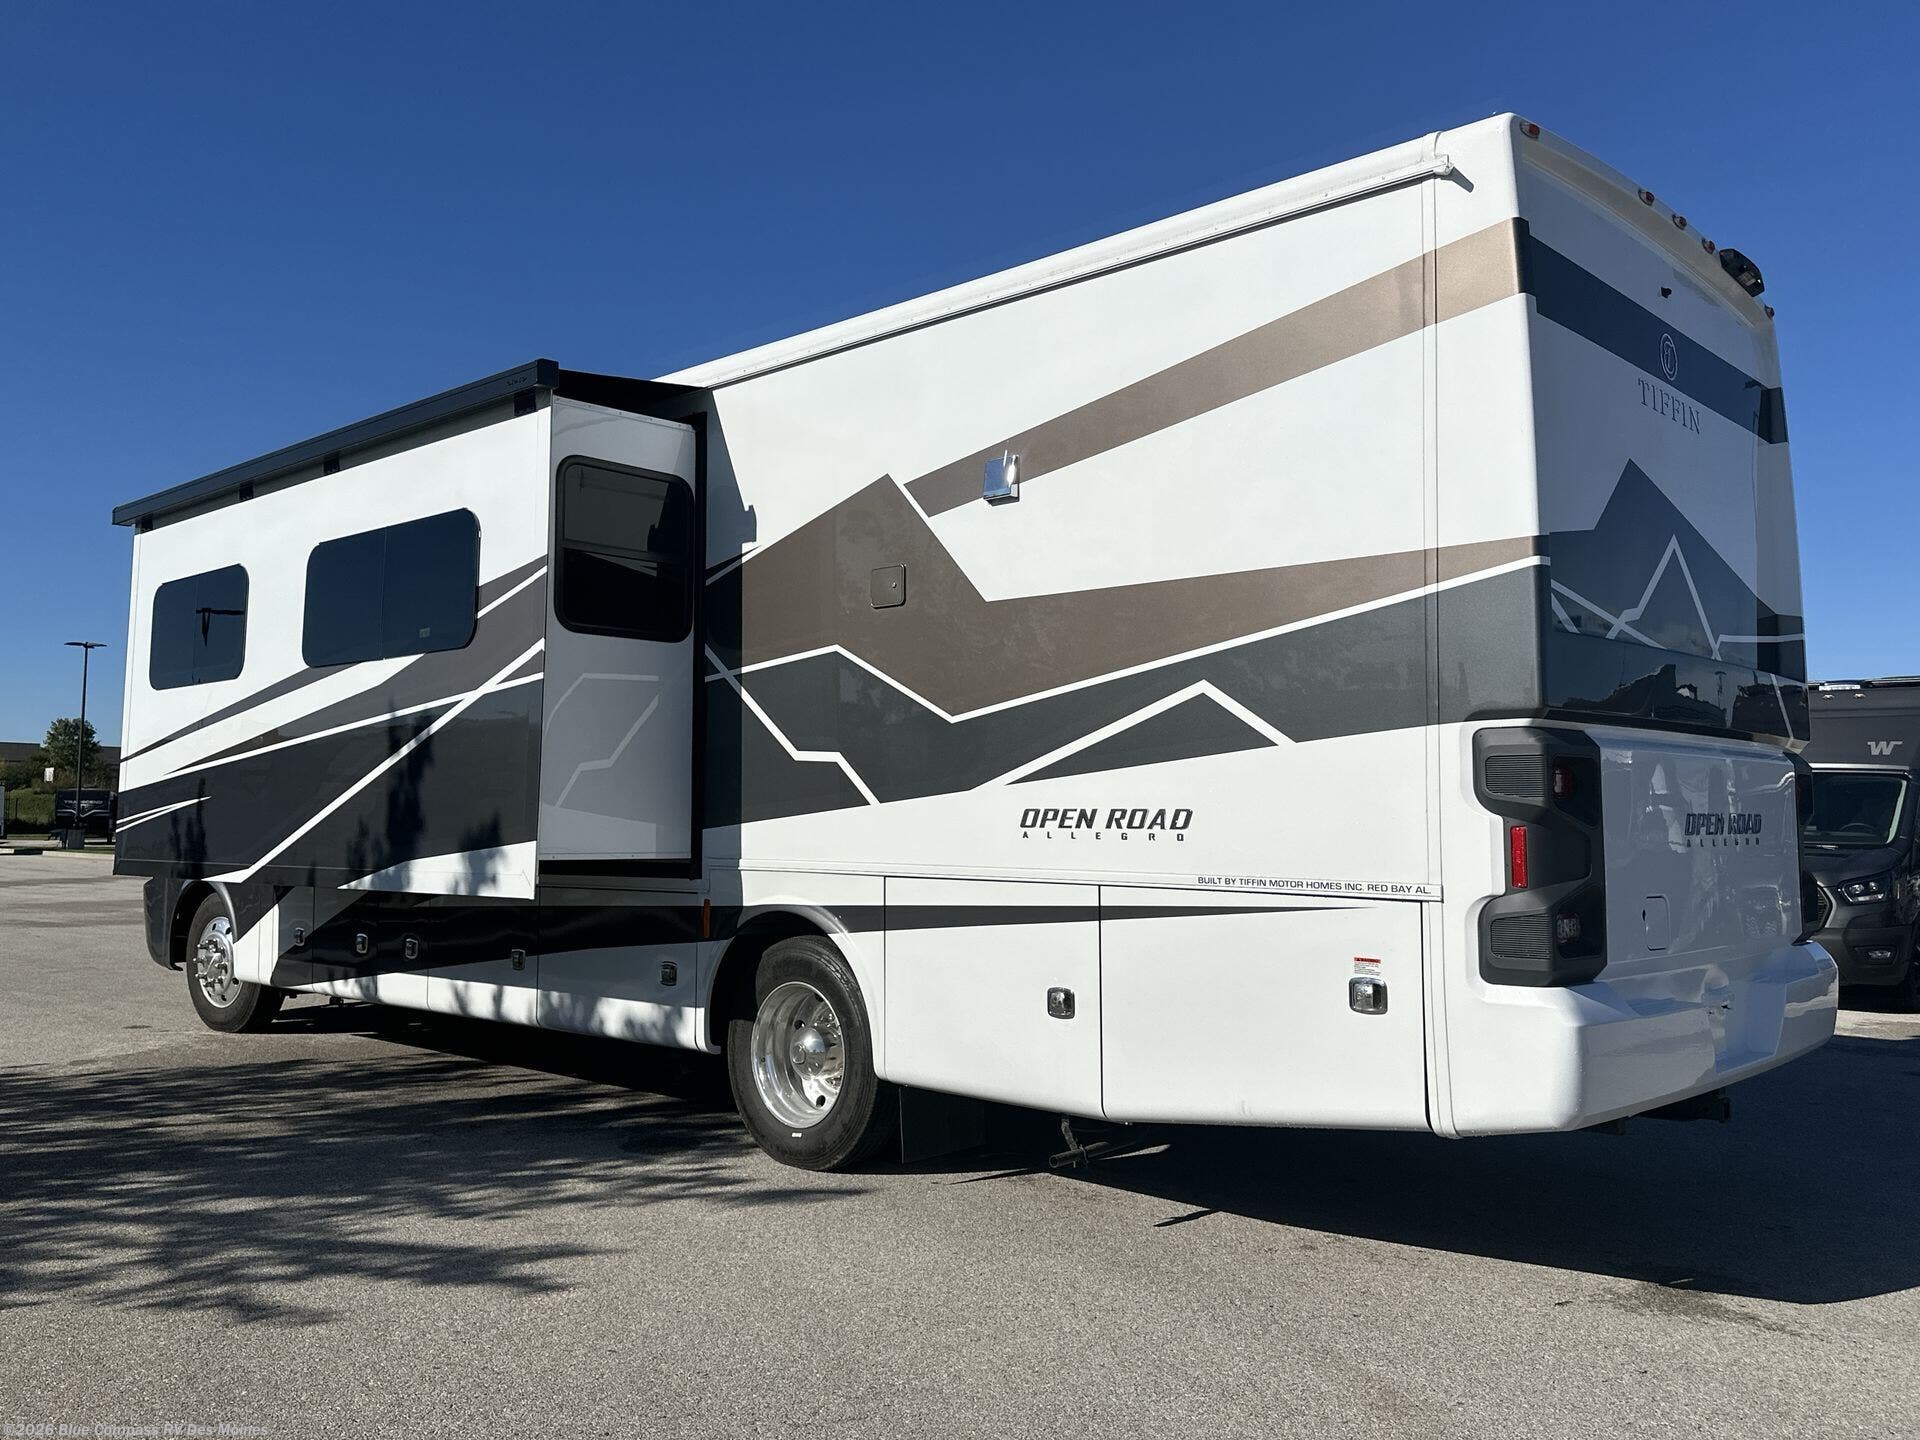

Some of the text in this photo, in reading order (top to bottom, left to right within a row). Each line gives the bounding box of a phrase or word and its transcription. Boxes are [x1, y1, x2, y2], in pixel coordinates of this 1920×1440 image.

[1638, 377, 1700, 434] TIFFIN
[1867, 740, 1903, 755] W
[1019, 808, 1193, 831] OPEN ROAD
[1685, 813, 1762, 836] OPEN ROAD
[1022, 831, 1184, 842] ALLEGRO
[1686, 837, 1760, 848] ALLEGRO
[1197, 876, 1223, 885] BUILT
[1224, 877, 1237, 886] BY
[1239, 878, 1267, 887] TIFFIN
[1269, 879, 1304, 889] MOTOR
[1306, 881, 1342, 890] HOMES
[1344, 882, 1365, 892] INC.
[1367, 883, 1388, 893] RED
[1391, 884, 1413, 894] BAY
